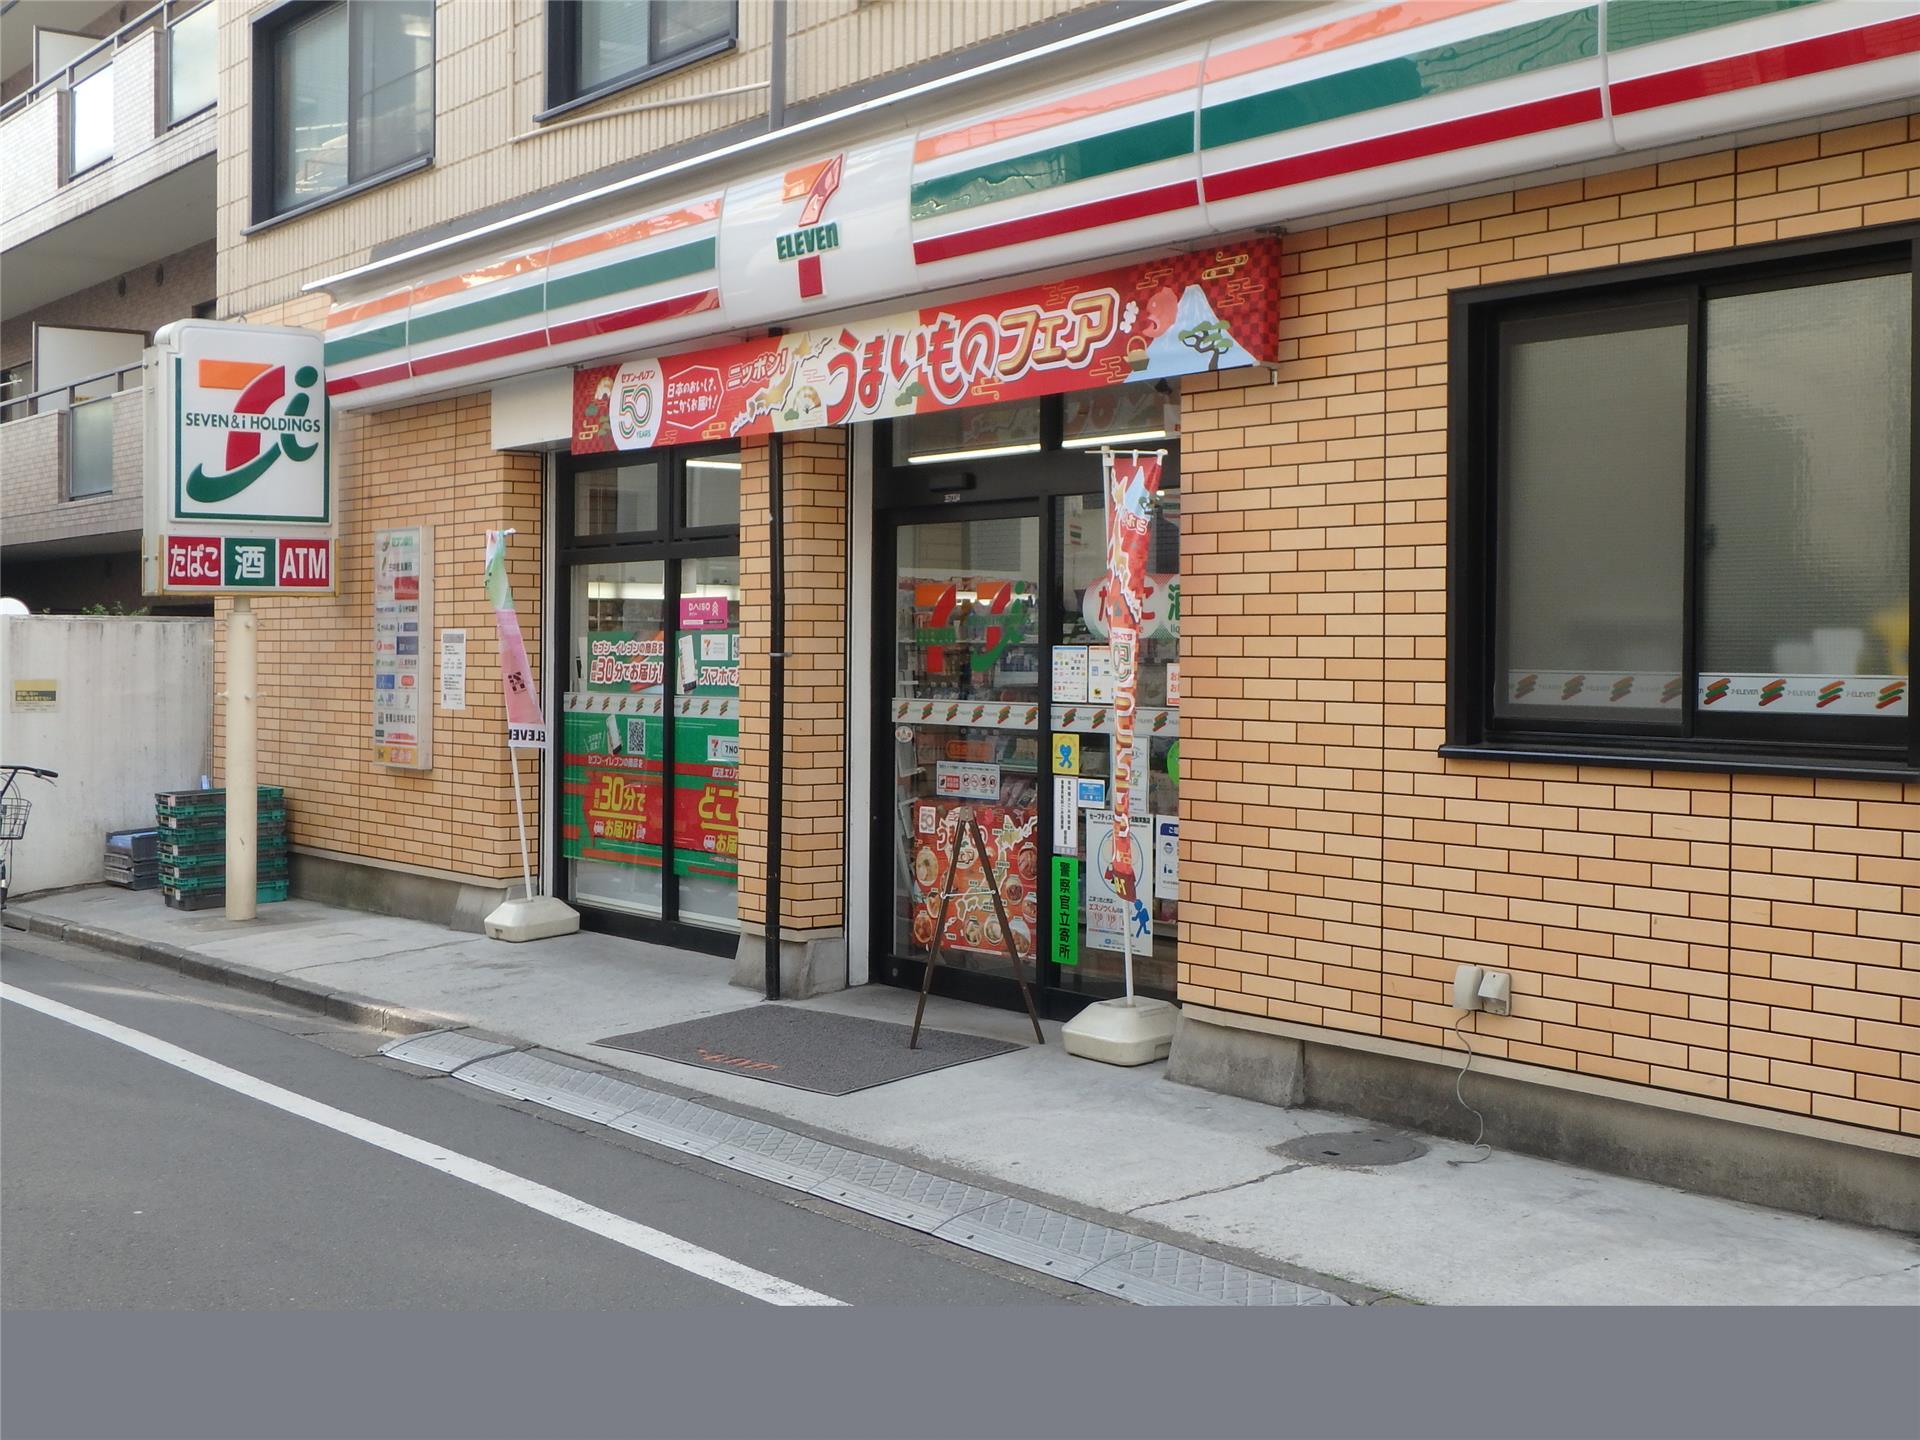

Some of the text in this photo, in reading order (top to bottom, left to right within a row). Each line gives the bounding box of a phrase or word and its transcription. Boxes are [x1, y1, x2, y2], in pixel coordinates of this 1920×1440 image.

[727, 349, 789, 389] ニッポン!
[826, 289, 1118, 425] うまいものフェア
[619, 383, 654, 439] 50
[666, 394, 719, 415] ここからお届け!
[185, 412, 321, 433] SEVEN&i HOLDINGS
[636, 430, 652, 439] YEARS
[170, 544, 219, 578] たばこ
[234, 545, 266, 579] 酒
[282, 547, 326, 580] ATM
[688, 602, 711, 611] DAISO
[605, 819, 637, 840] お届け!
[1059, 861, 1071, 960] 警察官立寄所
